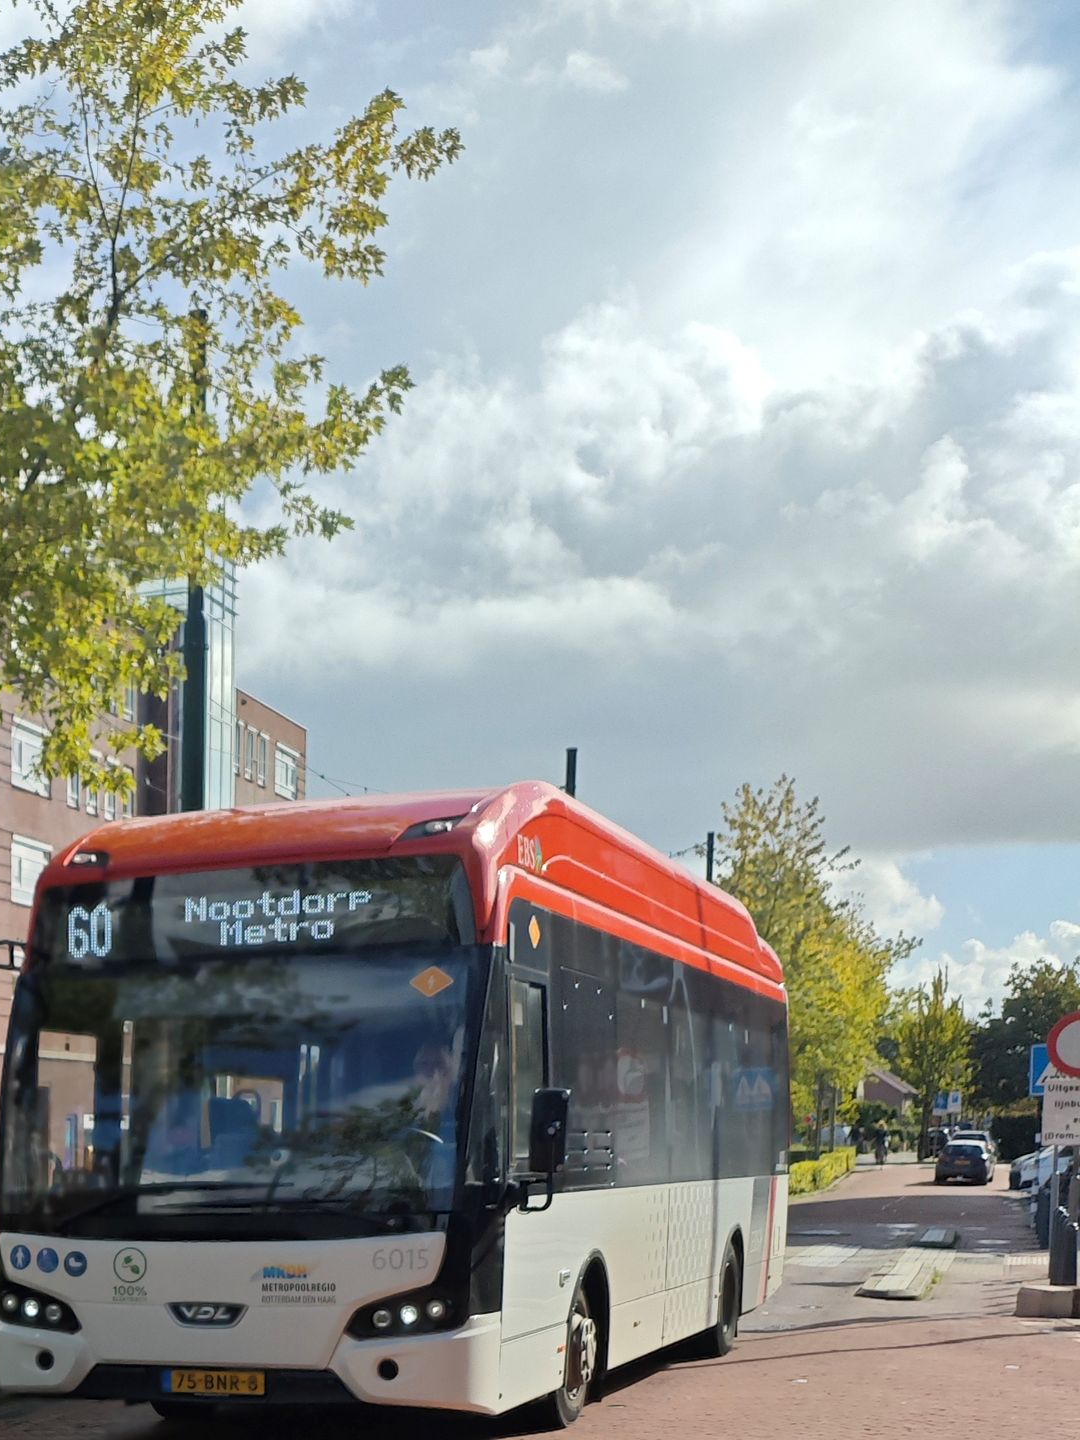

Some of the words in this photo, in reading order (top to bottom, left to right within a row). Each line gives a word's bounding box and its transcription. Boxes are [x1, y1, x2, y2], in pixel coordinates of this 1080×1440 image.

[517, 834, 535, 869] EBS
[68, 904, 113, 958] 60
[220, 916, 335, 946] Metro
[372, 1248, 429, 1270] 6015
[113, 1285, 147, 1296] 100%
[261, 1282, 336, 1292] METROPOOLREGIO
[261, 1295, 301, 1304] ROTTERDAM
[303, 1295, 316, 1303] DEN
[318, 1295, 336, 1304] HAAG
[181, 1306, 231, 1319] VDL
